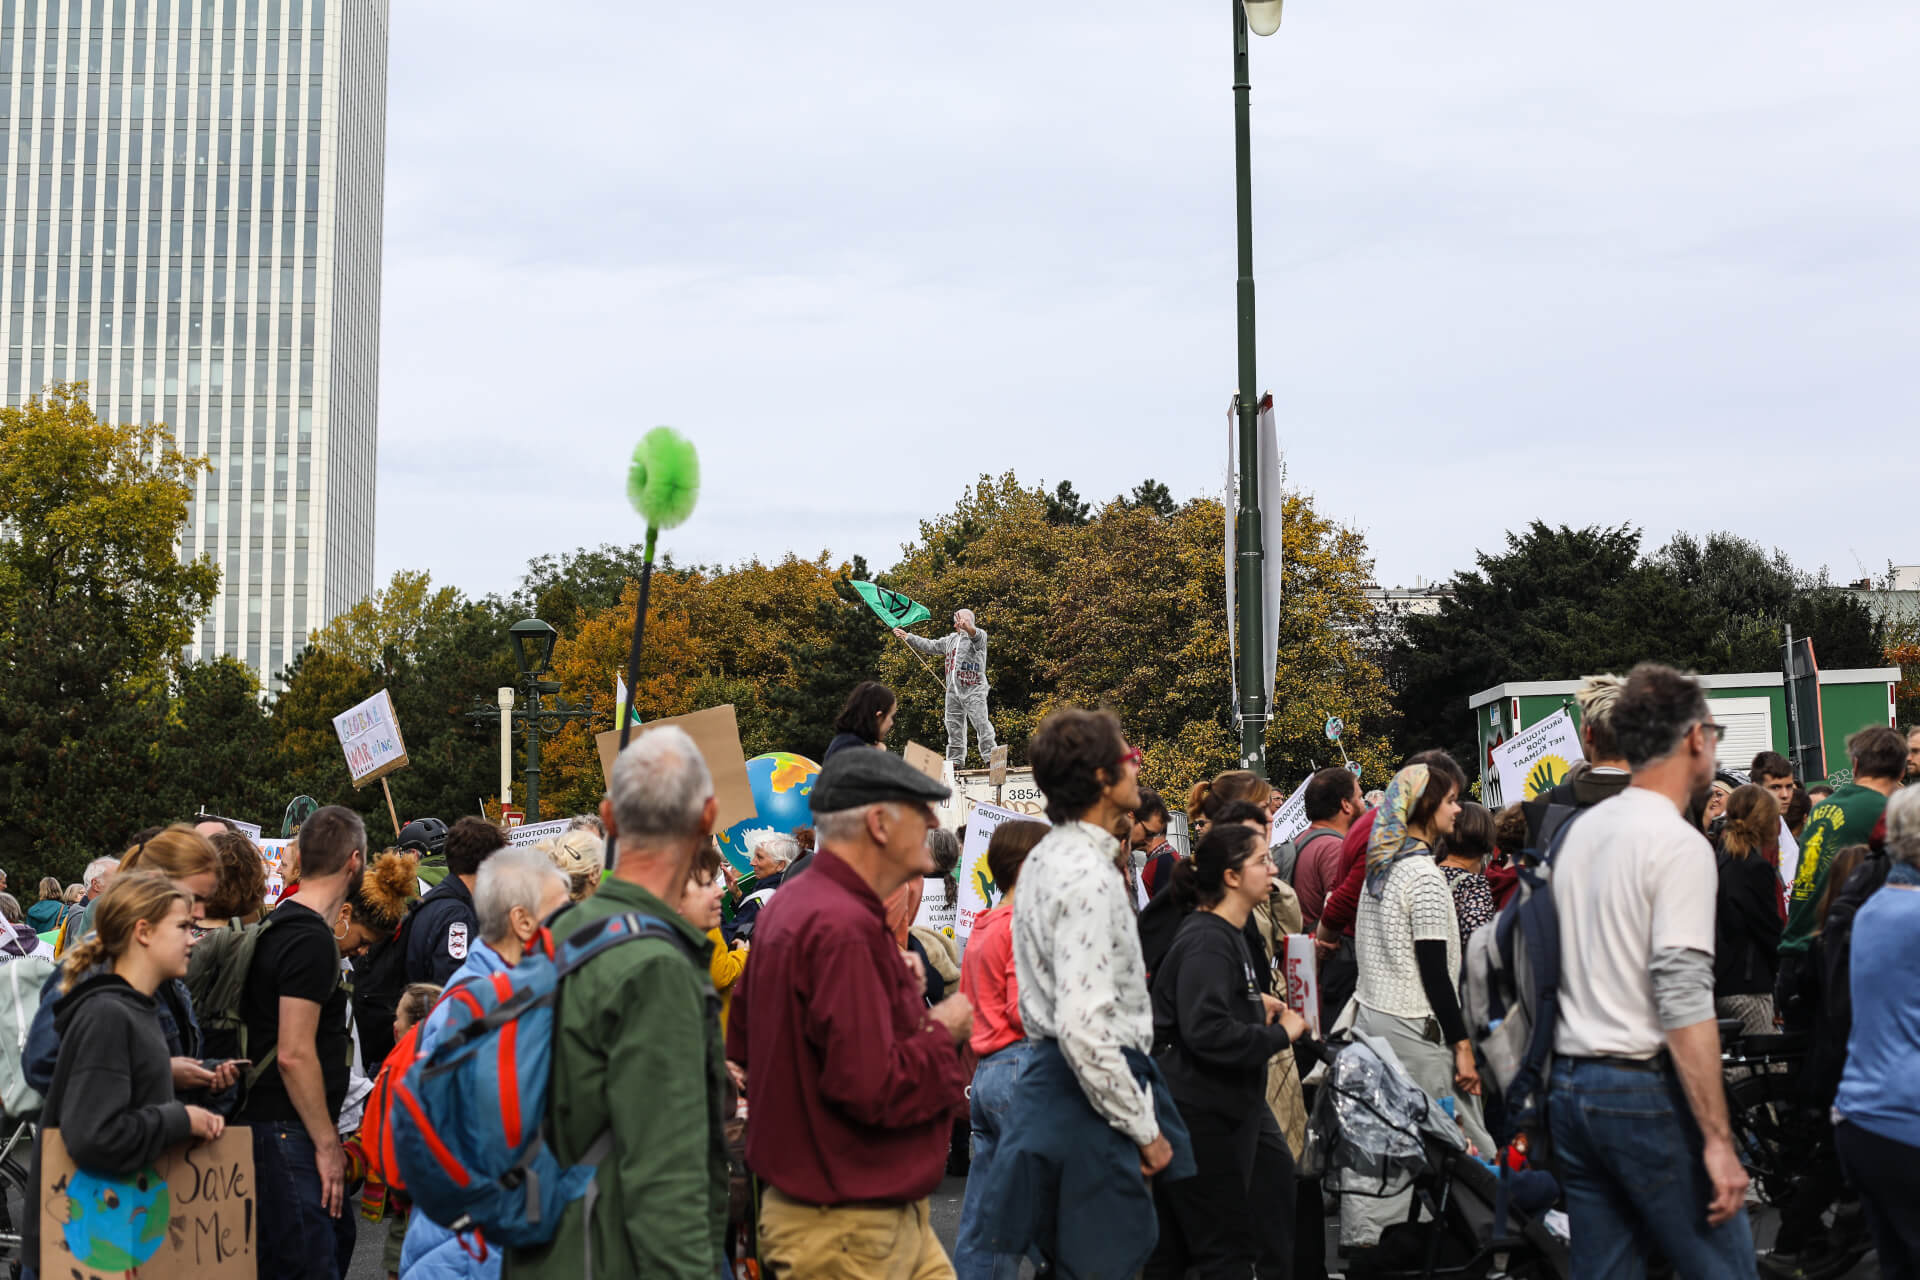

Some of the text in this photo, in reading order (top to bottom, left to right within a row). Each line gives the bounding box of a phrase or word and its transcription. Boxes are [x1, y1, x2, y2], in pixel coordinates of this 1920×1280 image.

[1008, 788, 1041, 800] 3854
[1296, 818, 1309, 832] KLI
[176, 1149, 248, 1204] Save
[195, 1198, 253, 1265] Me!
